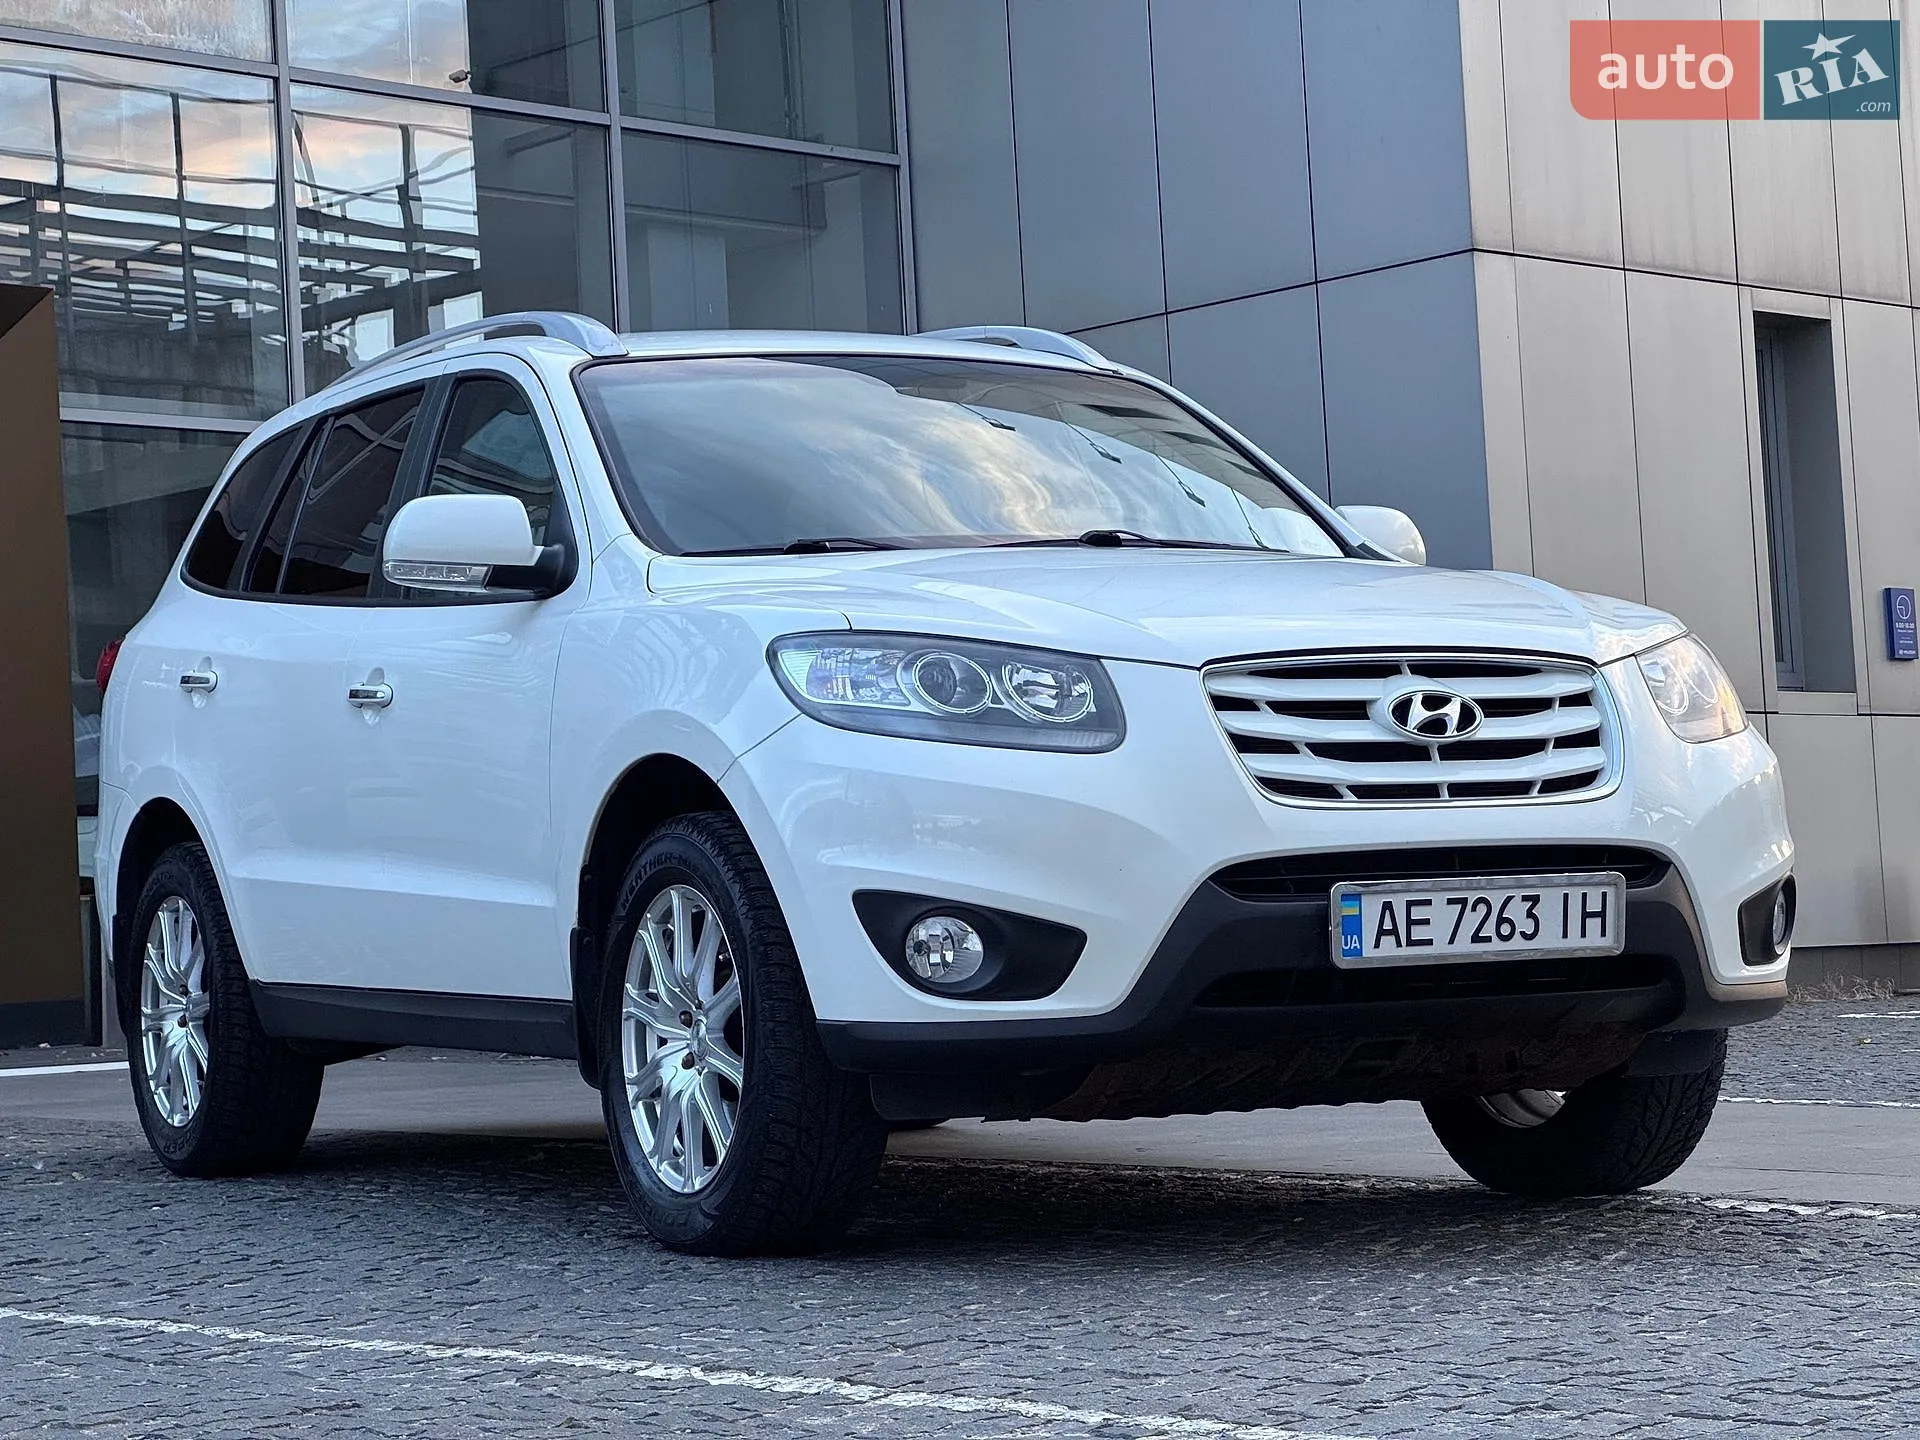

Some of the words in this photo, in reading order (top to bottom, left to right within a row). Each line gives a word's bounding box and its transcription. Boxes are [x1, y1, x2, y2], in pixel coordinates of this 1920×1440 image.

[1373, 898, 1434, 949] AE
[1446, 893, 1541, 945] 7263
[1562, 890, 1607, 939] IH
[1341, 935, 1361, 950] UA
